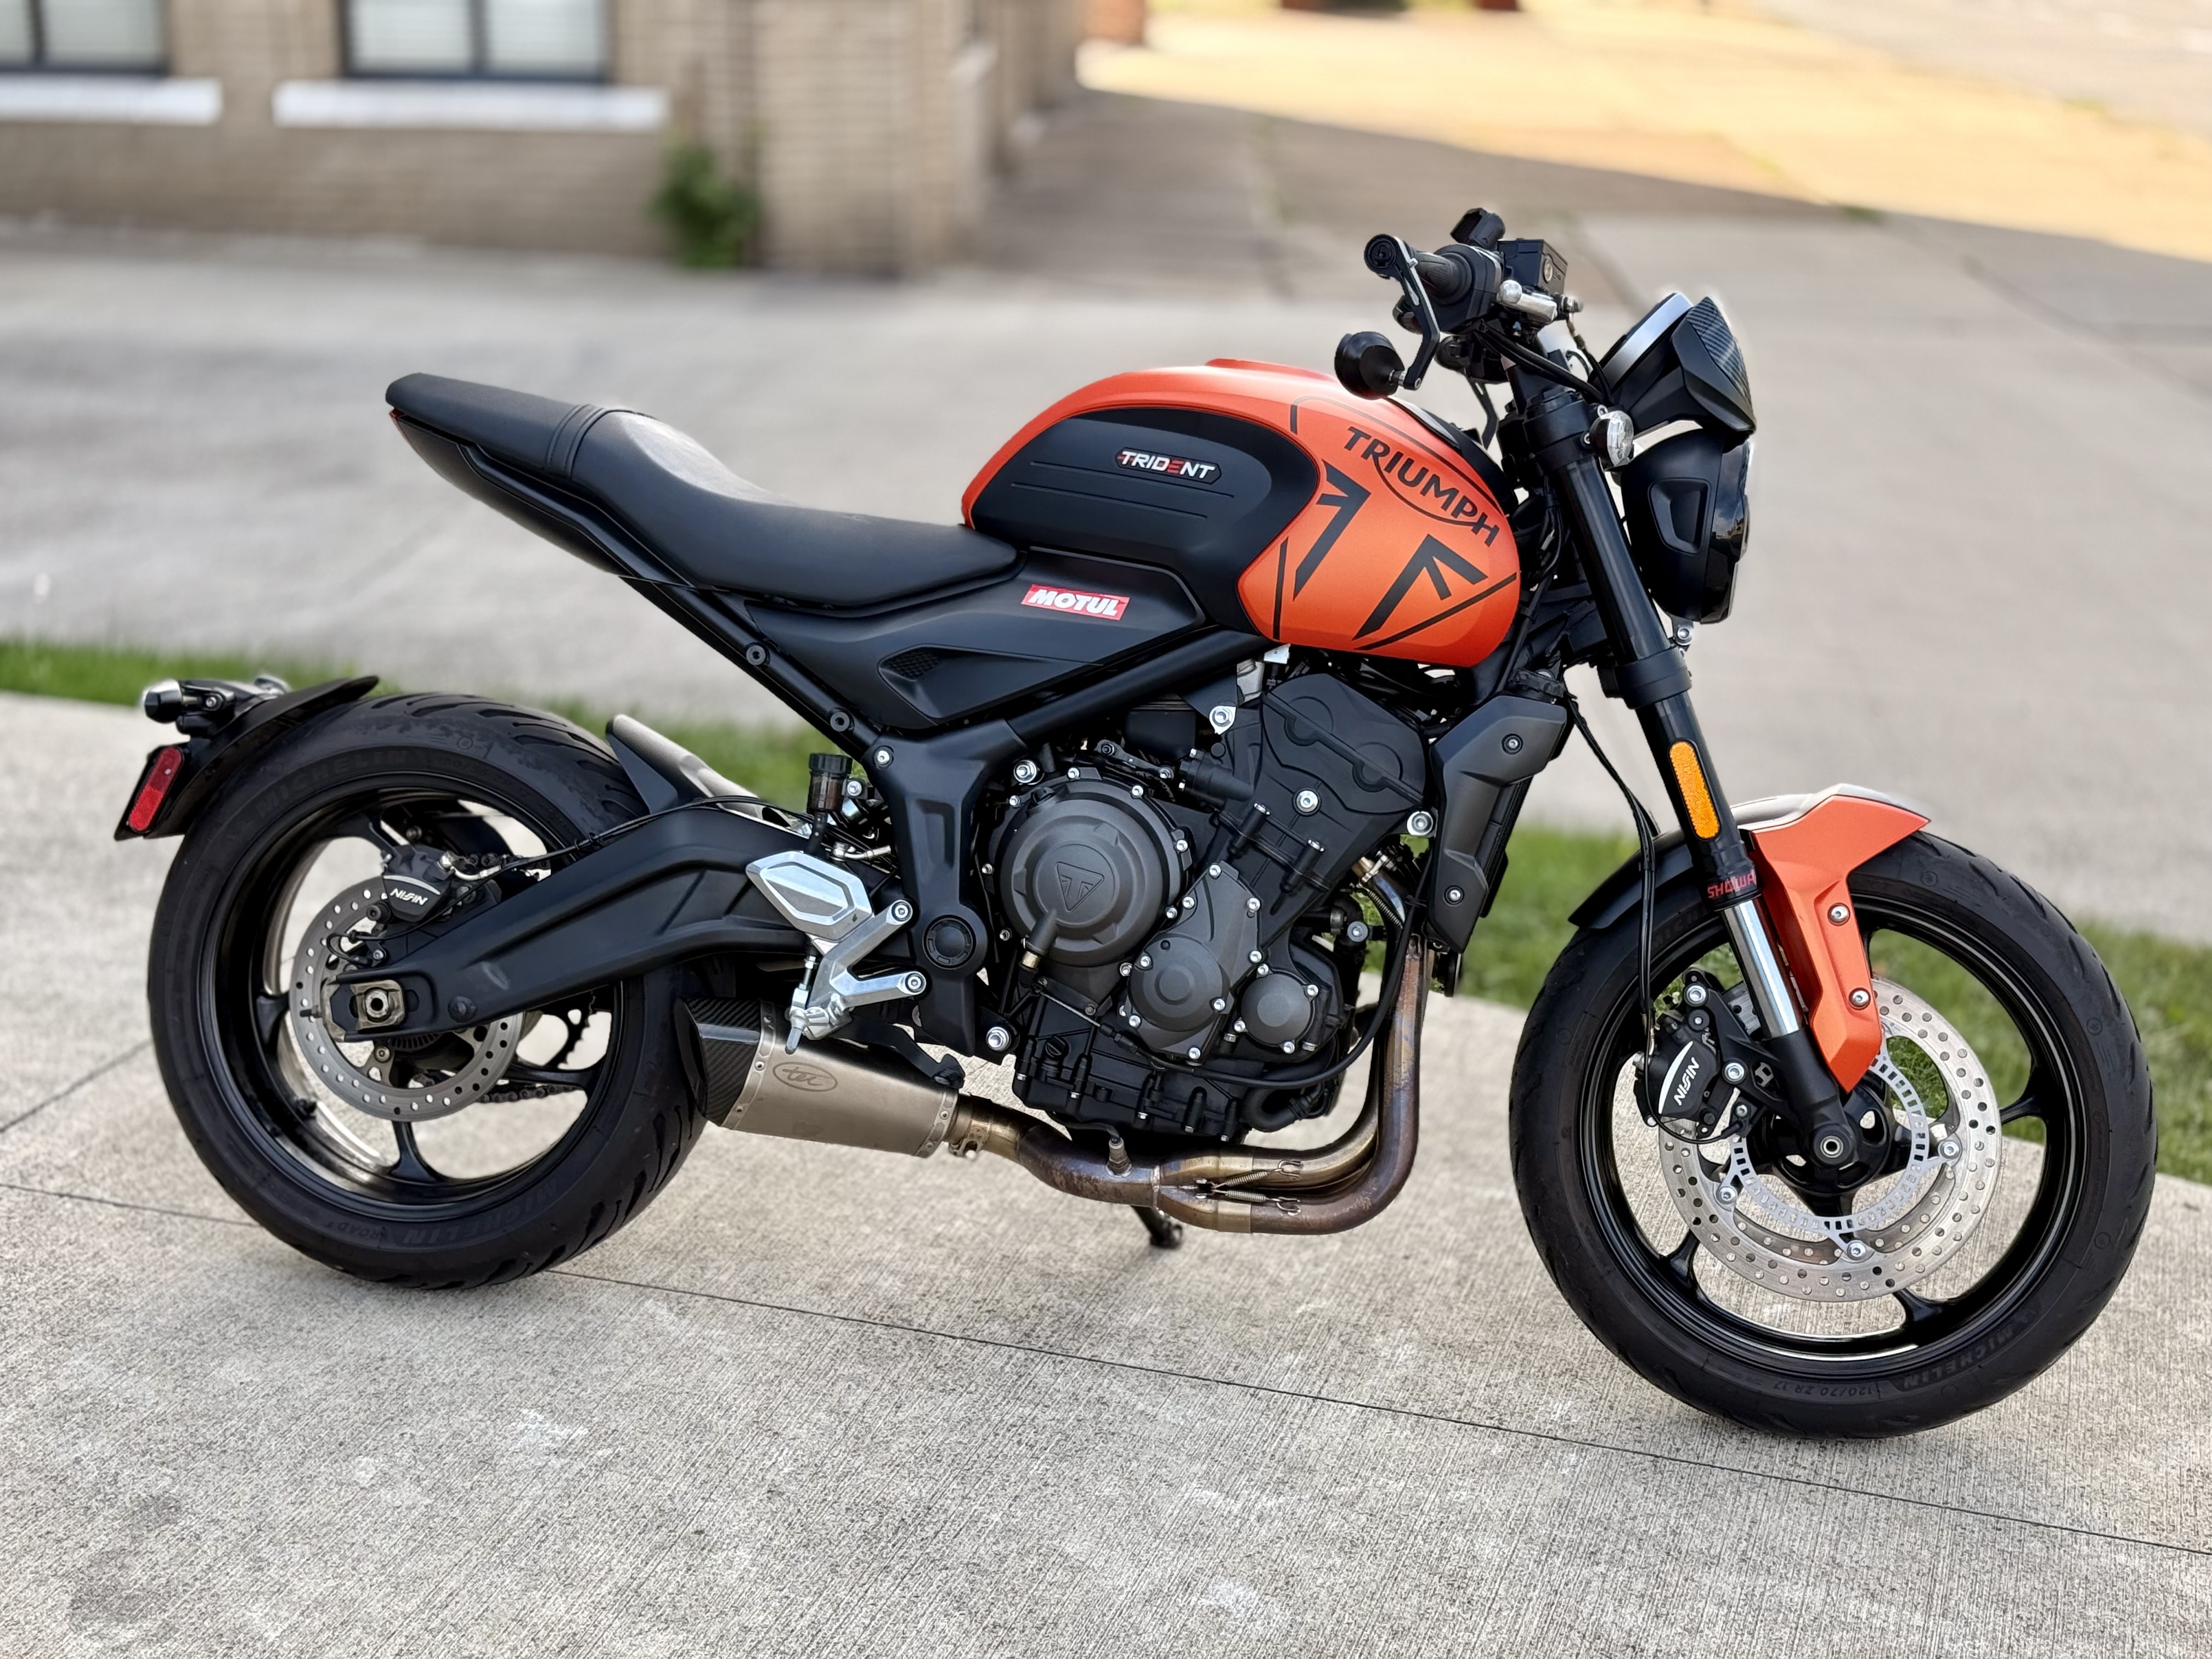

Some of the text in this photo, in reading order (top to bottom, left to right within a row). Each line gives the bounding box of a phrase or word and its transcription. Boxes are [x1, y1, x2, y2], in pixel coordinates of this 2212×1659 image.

[1120, 450, 1216, 480] TRIDENT
[1344, 426, 1500, 548] TRIUMPH
[1031, 589, 1120, 616] MOTUL
[254, 749, 408, 818] MICHELIN
[1707, 869, 1756, 899] SHOWA
[402, 1177, 558, 1244] MICHELIN
[336, 1221, 384, 1241] ROAD
[1903, 1325, 2014, 1388] MICHELIN
[1774, 1380, 1874, 1397] 120/70 ZR 17
